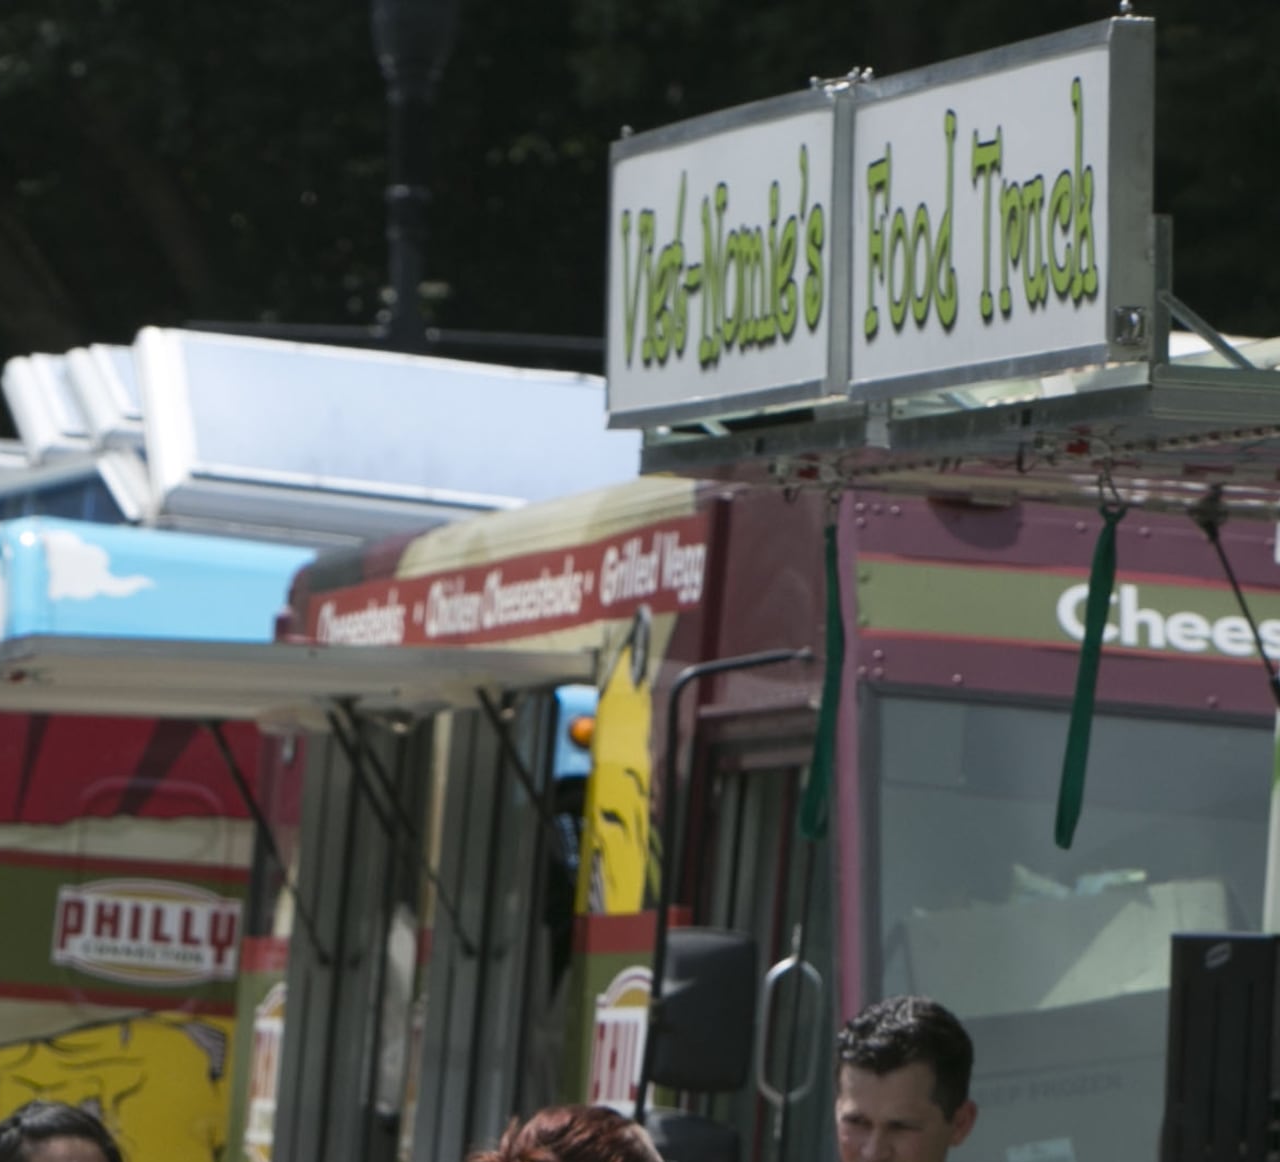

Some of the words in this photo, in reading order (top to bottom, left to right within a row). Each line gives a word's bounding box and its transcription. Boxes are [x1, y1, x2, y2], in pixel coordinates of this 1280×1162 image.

[864, 108, 959, 344] Food
[970, 76, 1099, 325] Truck
[600, 530, 661, 607] Grilled
[58, 899, 237, 965] PHILLY
